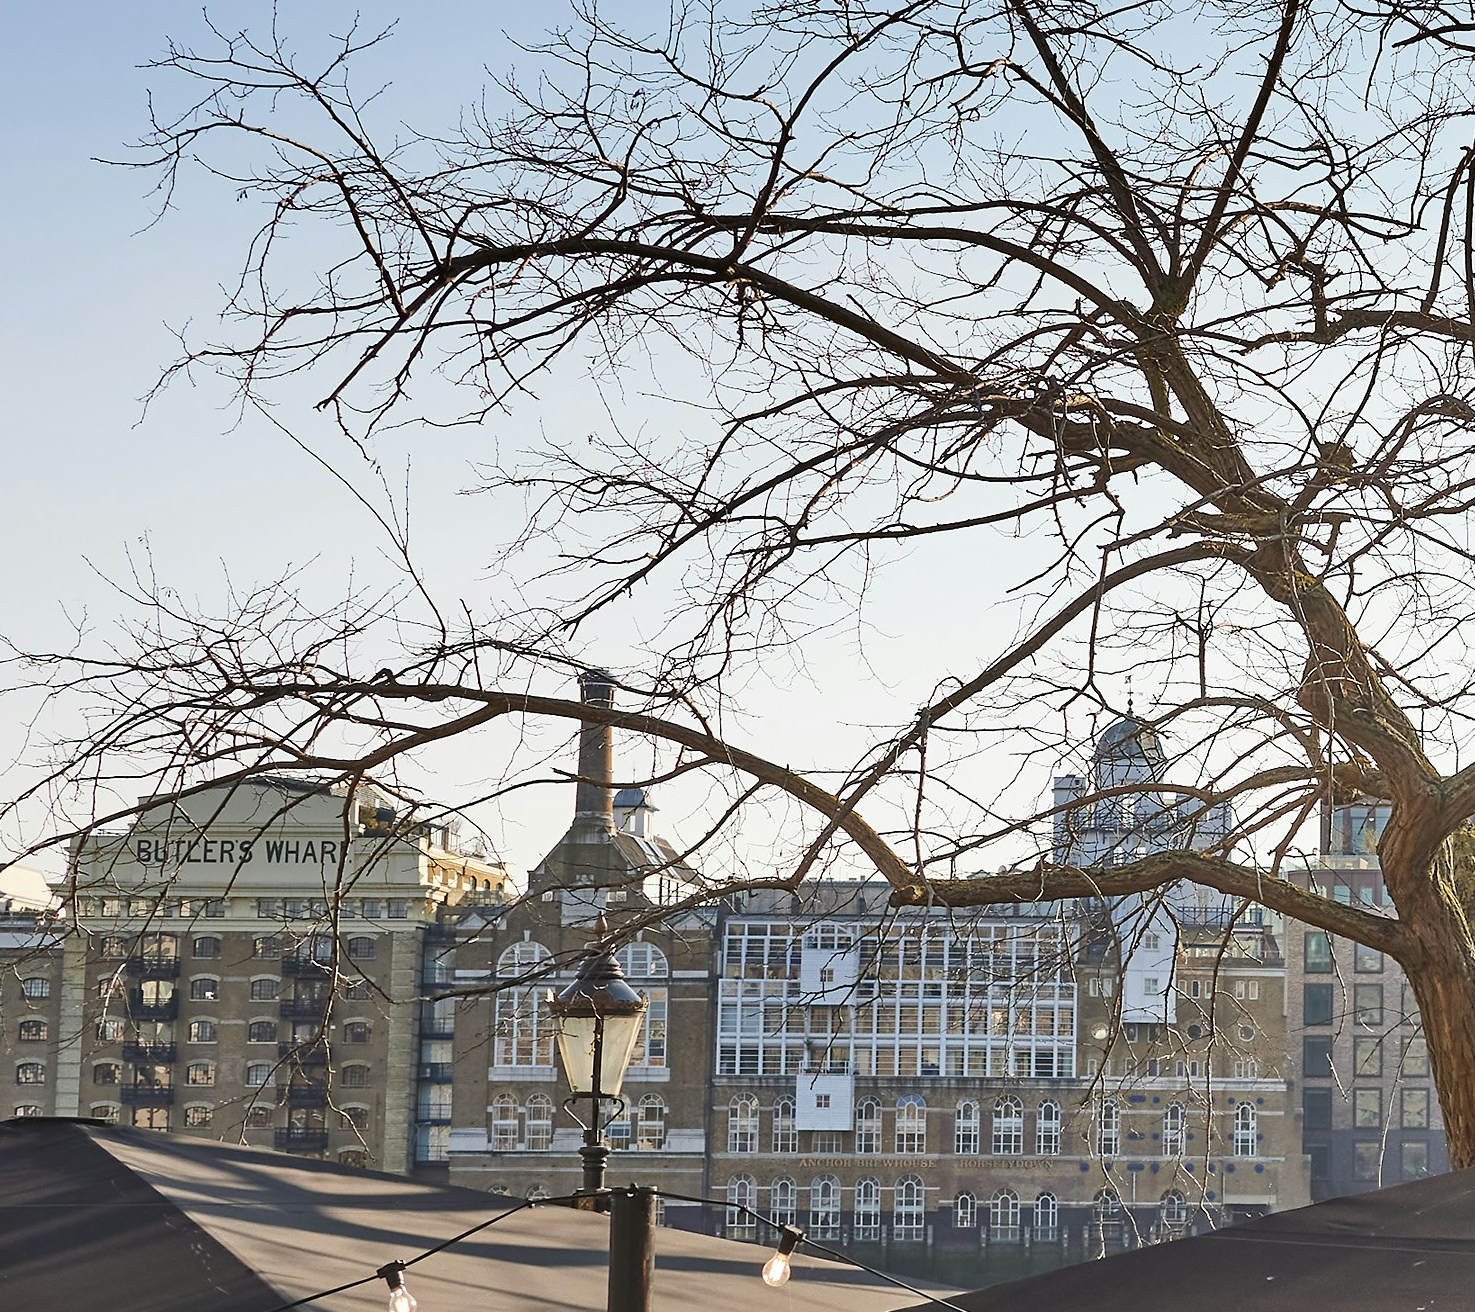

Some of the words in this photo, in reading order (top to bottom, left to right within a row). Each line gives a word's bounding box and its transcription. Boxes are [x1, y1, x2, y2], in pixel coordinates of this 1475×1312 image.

[137, 840, 254, 865] BUTLER'S
[265, 840, 353, 865] WHAR.
[798, 1158, 851, 1168] ANCHOR
[856, 1158, 937, 1169] BREWHOUSE
